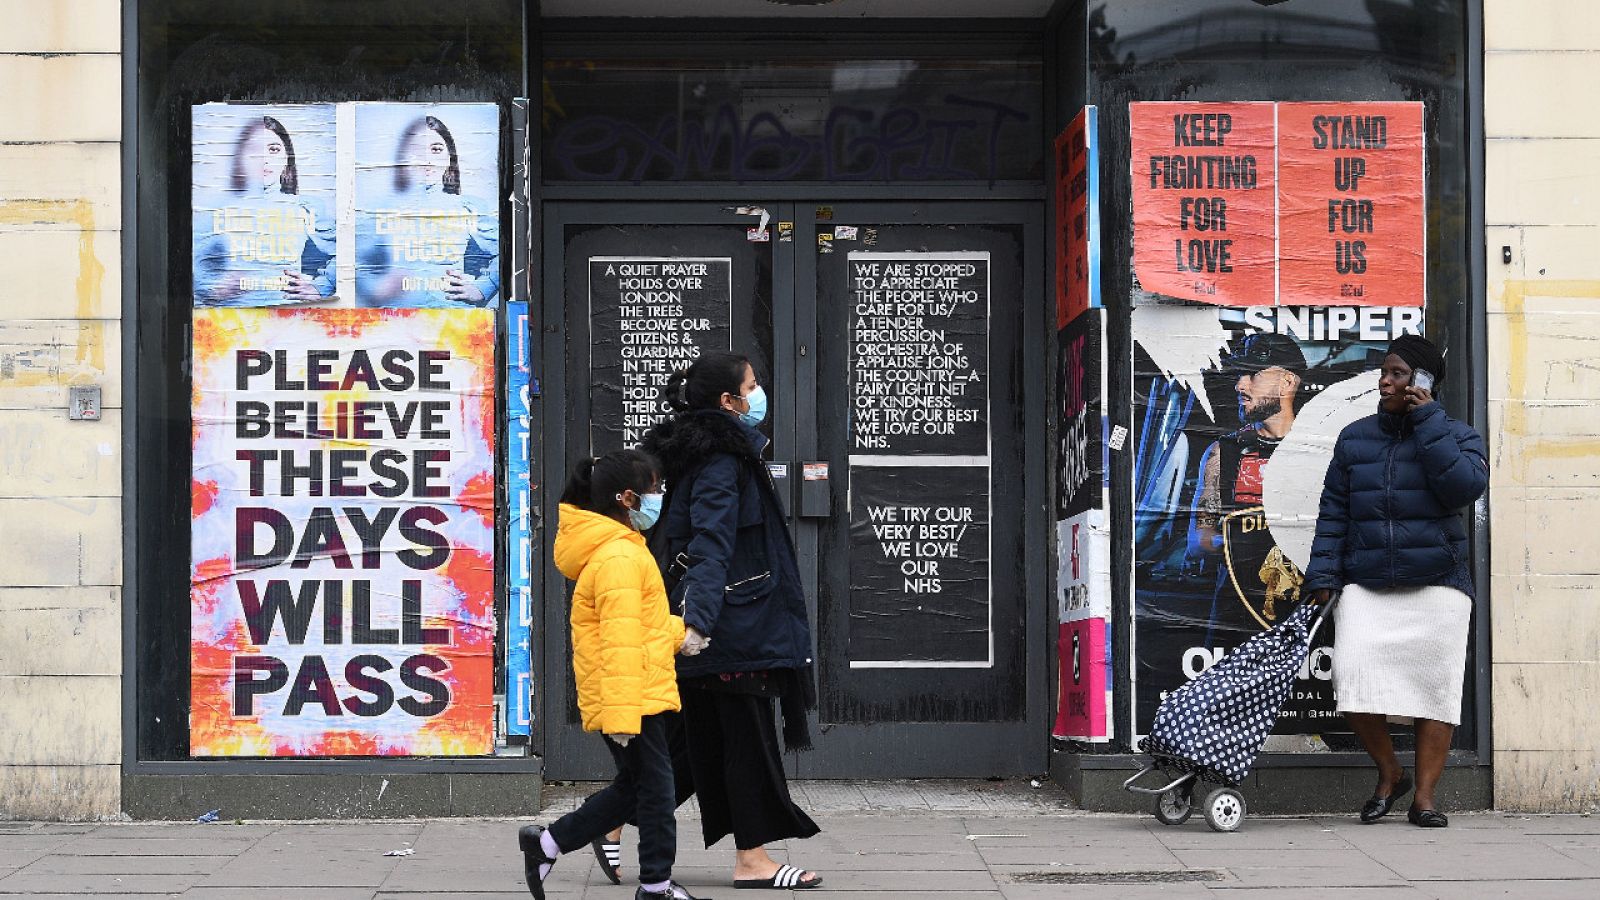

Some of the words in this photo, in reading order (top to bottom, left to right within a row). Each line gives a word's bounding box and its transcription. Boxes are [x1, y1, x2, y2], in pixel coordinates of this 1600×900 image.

[1173, 113, 1232, 147] KEEP
[1312, 115, 1387, 150] STAND
[1150, 155, 1257, 190] FIGHTING
[1334, 157, 1366, 192] UP
[1180, 197, 1227, 232] FOR
[1328, 199, 1374, 233] FOR
[1175, 239, 1233, 273] LOVE
[1335, 240, 1367, 275] US
[605, 264, 616, 276] A
[619, 264, 658, 276] QUIET
[662, 264, 708, 276] PRAYER
[855, 264, 880, 276] WE
[884, 264, 910, 276] ARE
[914, 264, 976, 276] STOPPED
[620, 278, 662, 290] HOLDS
[666, 278, 702, 290] OVER
[855, 277, 876, 289] TO
[880, 277, 959, 289] APPRECIATE
[620, 292, 682, 304] LONDON
[855, 290, 881, 303] THE
[886, 290, 934, 303] PEOPLE
[939, 290, 978, 303] WHO
[619, 305, 644, 317] THE
[646, 305, 684, 317] TREES
[856, 304, 893, 316] CARE
[897, 304, 925, 316] FOR
[930, 303, 957, 318] US/
[620, 319, 678, 331] BECOME
[681, 319, 710, 331] OUR
[856, 317, 866, 329] A
[870, 317, 924, 329] TENDER
[621, 333, 678, 345] CITIZENS
[682, 333, 693, 345] &
[856, 330, 944, 342] PERCUSSION
[621, 346, 700, 358] GUARDIANS
[856, 343, 940, 355] ORCHESTRA
[943, 343, 963, 355] OF
[623, 360, 638, 372] IN
[642, 360, 666, 372] THE
[855, 356, 923, 368] APPLAUSE
[926, 356, 969, 369] JOINS
[236, 350, 451, 392] PLEASE
[855, 370, 881, 381] THE
[622, 374, 646, 385] THE
[623, 388, 659, 400] HOLD
[855, 383, 892, 395] FAIRY
[896, 383, 936, 395] LIGHT
[940, 383, 967, 395] NET
[622, 401, 657, 413] THEIR
[855, 396, 876, 408] OF
[880, 396, 955, 408] KINDNESS.
[236, 401, 451, 440] BELIEVE
[624, 415, 665, 427] SILENT
[855, 409, 880, 422] WE
[884, 409, 908, 422] TRY
[912, 409, 943, 422] OUR
[947, 409, 979, 422] BEST
[624, 429, 638, 440] IN
[855, 423, 880, 435] WE
[885, 423, 919, 435] LOVE
[923, 423, 955, 435] OUR
[855, 435, 890, 448] NHS.
[236, 450, 451, 498] THESE
[868, 506, 897, 522] WE
[901, 506, 930, 522] TRY
[935, 506, 973, 522] OUR
[235, 506, 450, 571] DAYS
[872, 525, 914, 540] VERY
[920, 524, 967, 542] BEST/
[881, 542, 910, 558] WE
[916, 542, 958, 558] LOVE
[901, 560, 939, 576] OUR
[904, 577, 942, 594] NHS
[236, 580, 451, 645] WILL
[234, 653, 451, 716] PASS
[1289, 691, 1322, 700] IDAL
